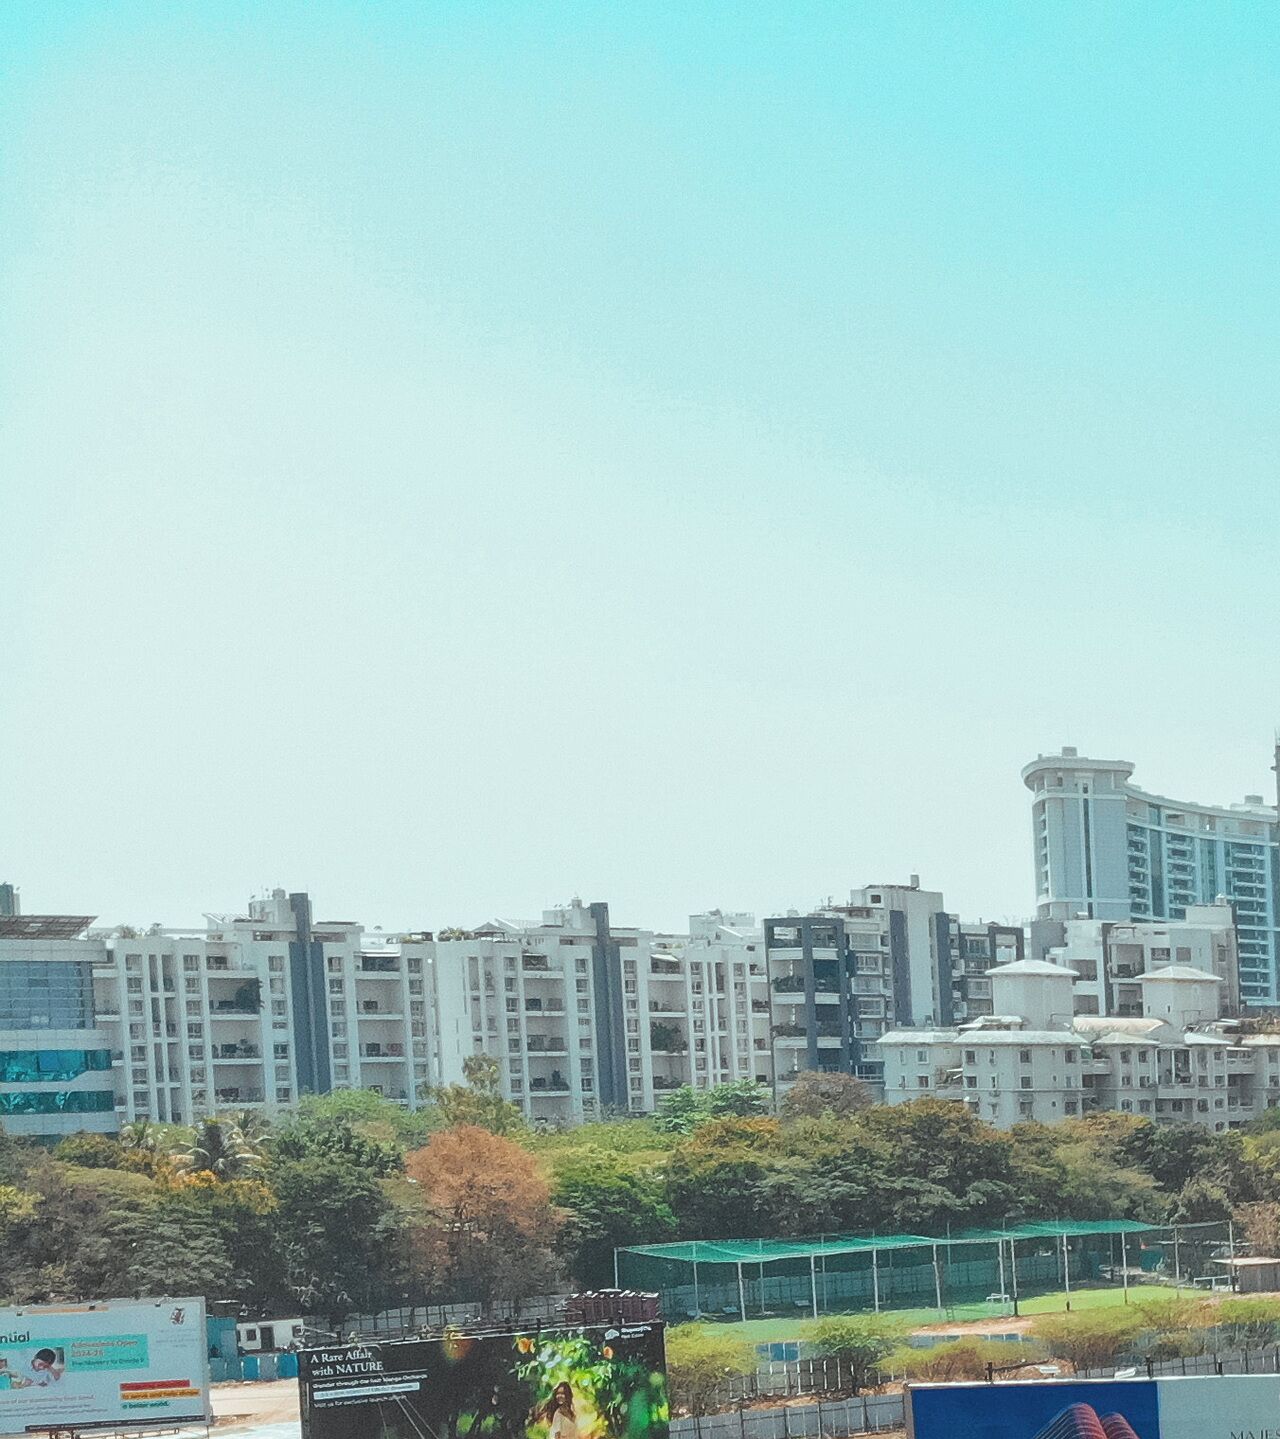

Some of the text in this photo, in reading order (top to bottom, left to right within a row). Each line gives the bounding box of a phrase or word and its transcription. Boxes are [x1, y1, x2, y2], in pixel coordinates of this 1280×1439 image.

[310, 1349, 372, 1364] A Rare Affair
[312, 1361, 384, 1376] with NATURE
